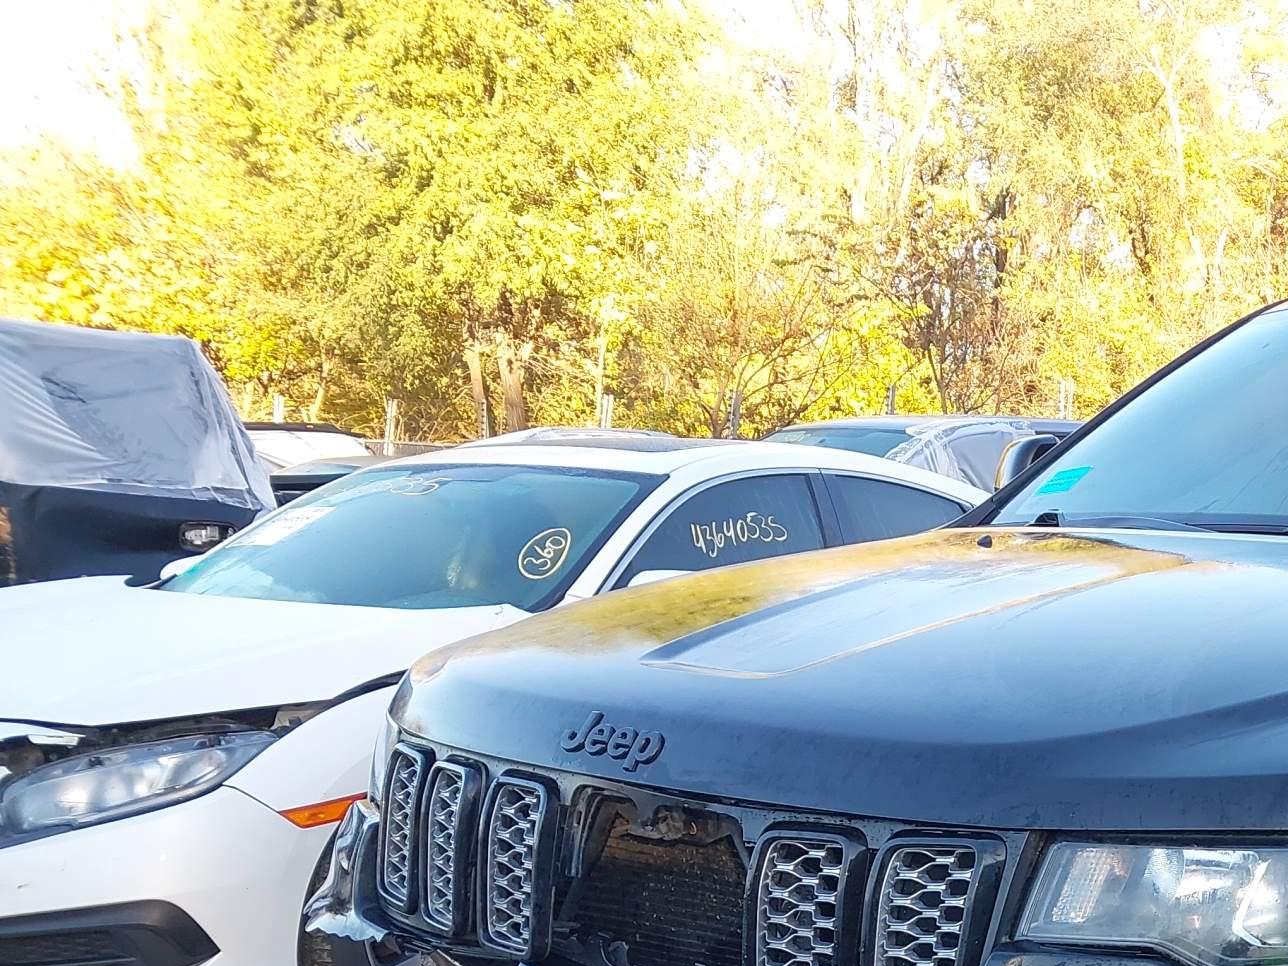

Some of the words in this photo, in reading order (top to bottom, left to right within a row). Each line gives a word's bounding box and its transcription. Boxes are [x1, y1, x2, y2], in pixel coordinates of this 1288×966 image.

[523, 535, 566, 571] 360
[689, 511, 788, 558] 43640535
[559, 709, 666, 773] Jeep
